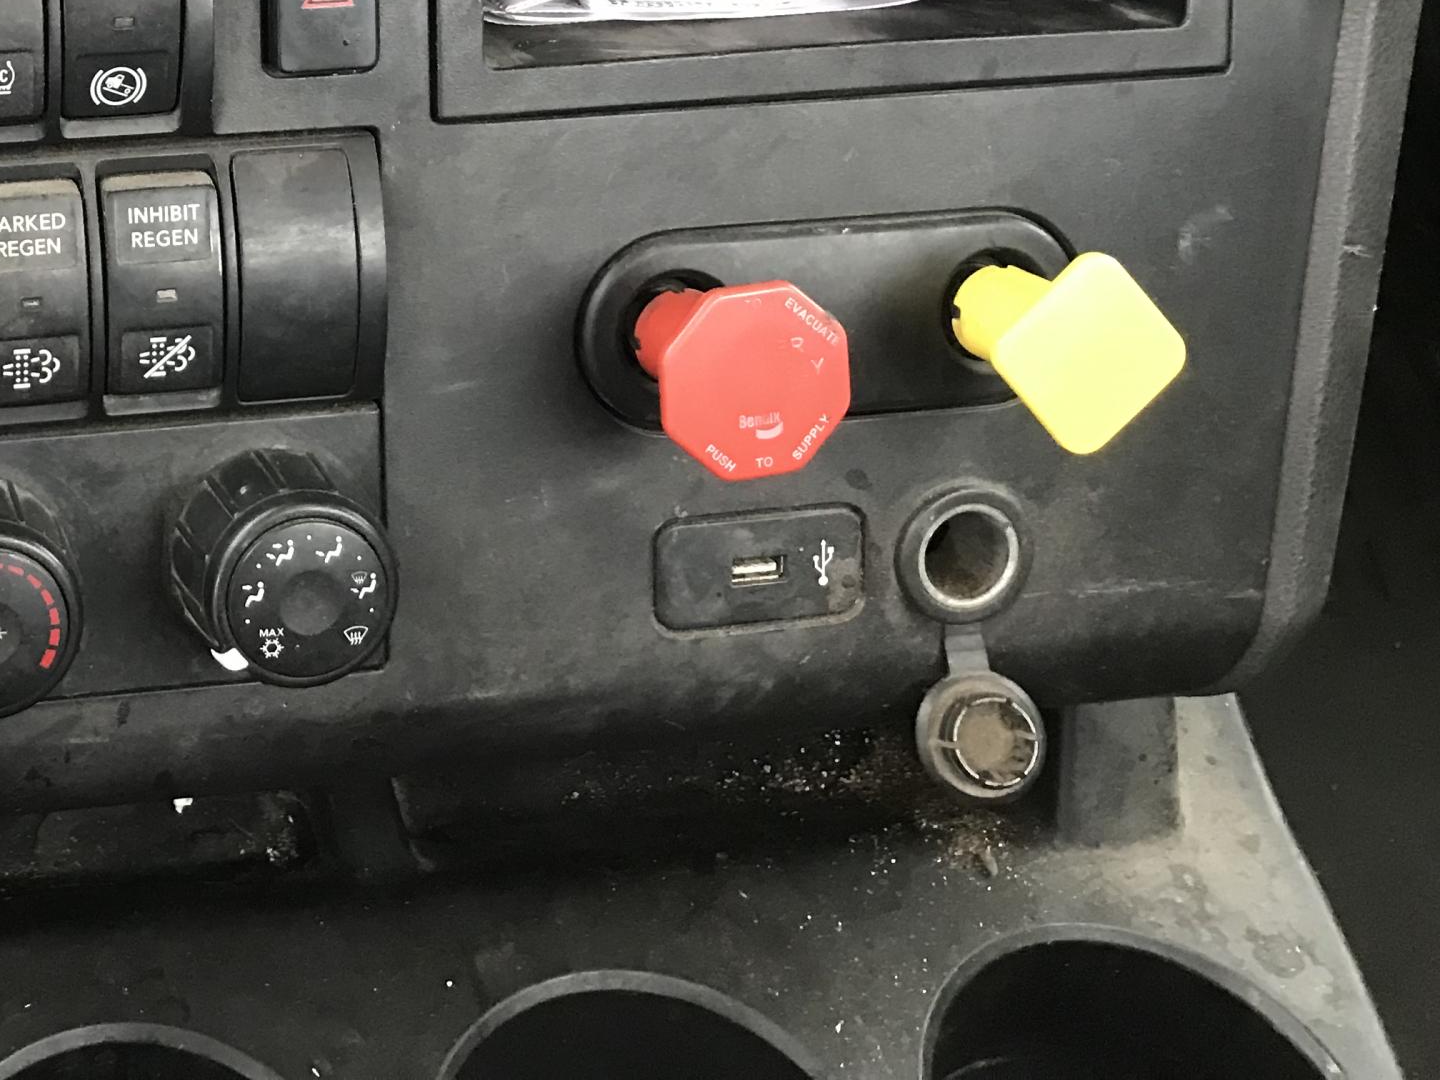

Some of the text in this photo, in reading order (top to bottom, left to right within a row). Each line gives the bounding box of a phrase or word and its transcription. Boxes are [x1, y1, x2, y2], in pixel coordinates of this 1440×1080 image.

[127, 203, 201, 225] INHIBIT
[131, 227, 199, 249] REGEN
[784, 296, 840, 347] EVACUATE
[705, 413, 830, 472] PUSH TO SUPPLY
[259, 627, 284, 637] MAX
